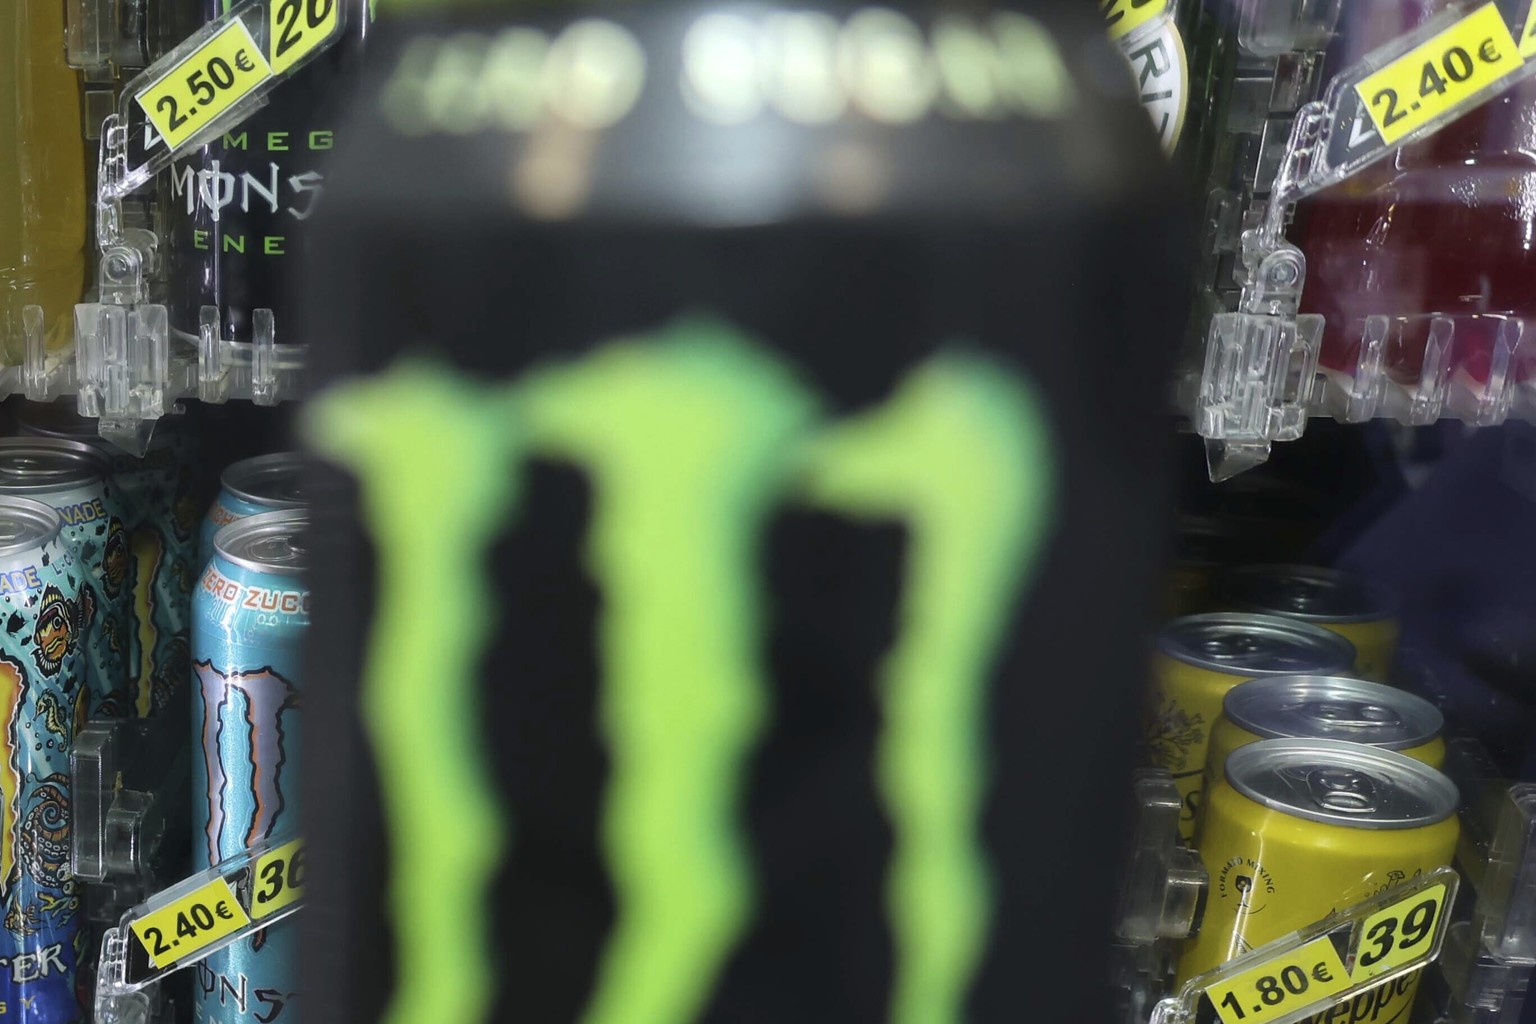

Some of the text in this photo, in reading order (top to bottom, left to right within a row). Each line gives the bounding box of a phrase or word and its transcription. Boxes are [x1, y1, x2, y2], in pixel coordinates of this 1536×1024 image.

[156, 48, 256, 132] 2.50€
[1371, 37, 1503, 129] 2.40€
[201, 567, 239, 602] ZERO
[144, 900, 234, 957] 2.40€
[1359, 899, 1437, 967] 39
[1221, 961, 1333, 1023] 1.80€
